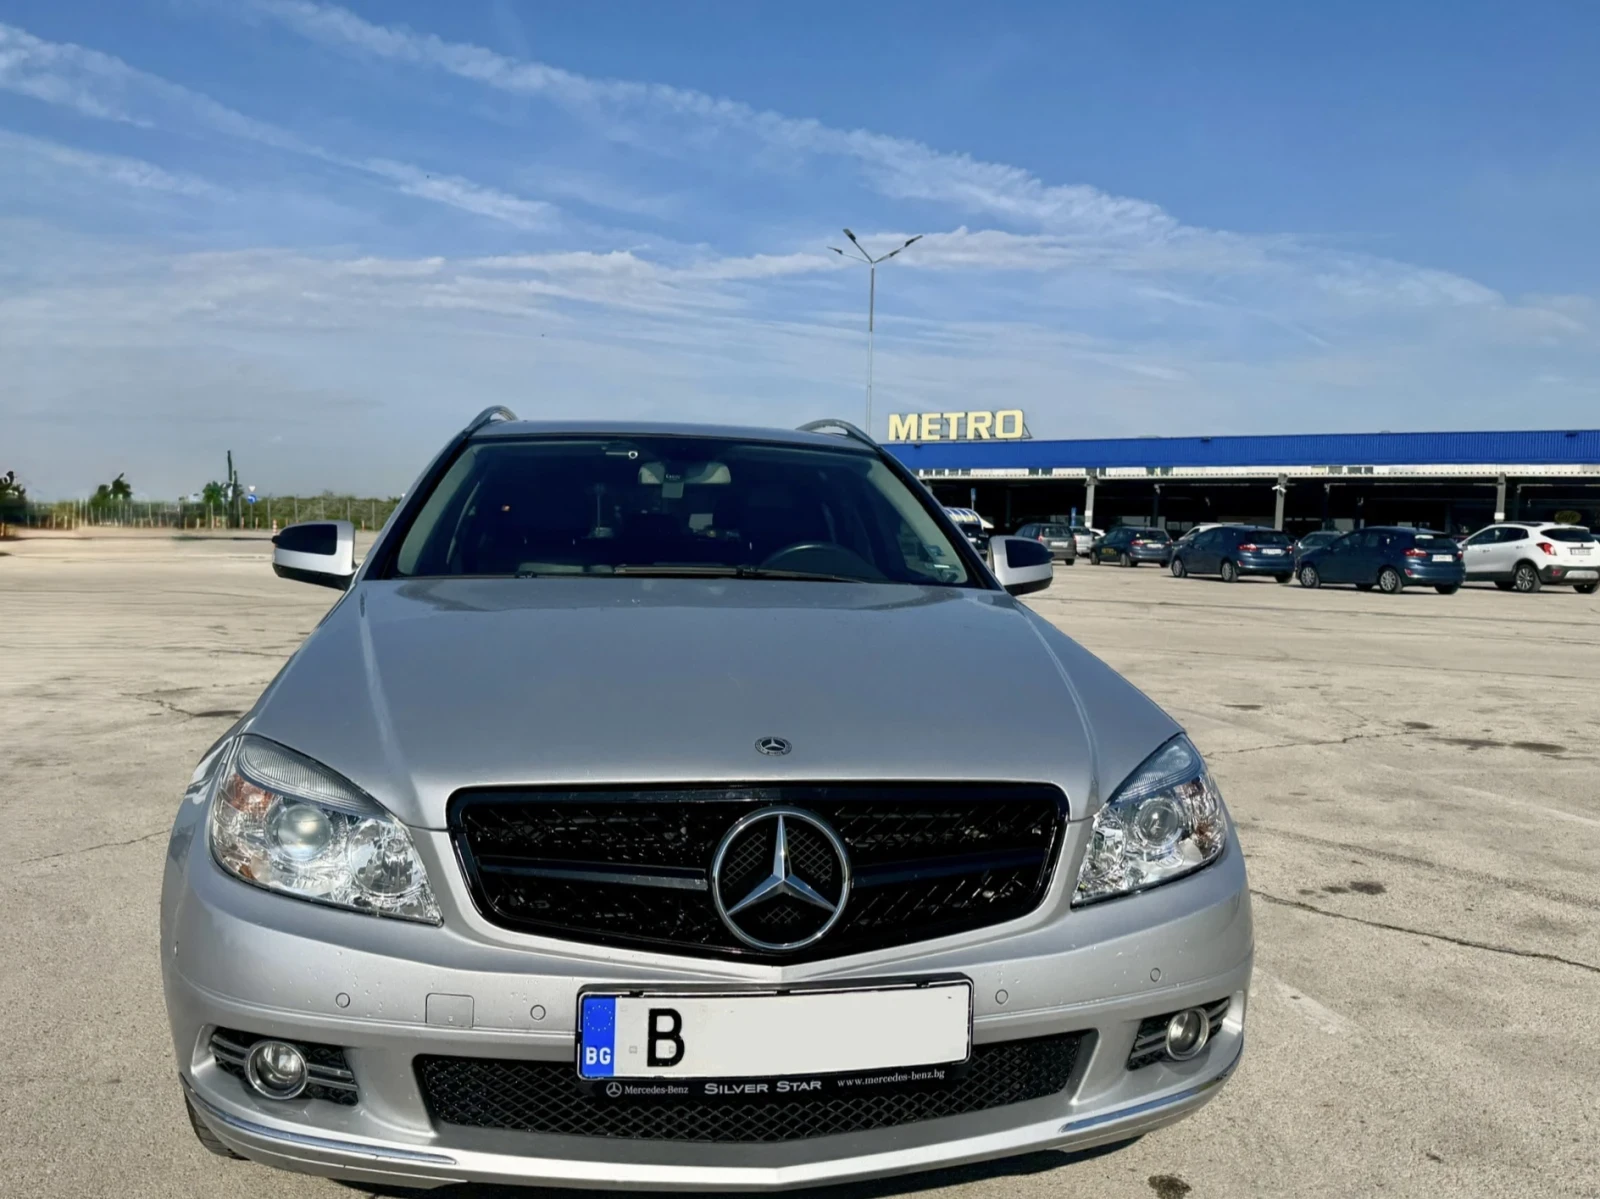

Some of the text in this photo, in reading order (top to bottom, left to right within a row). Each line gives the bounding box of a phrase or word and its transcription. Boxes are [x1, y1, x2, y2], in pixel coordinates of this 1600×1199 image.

[888, 410, 1024, 441] METRO
[647, 1008, 685, 1067] B
[585, 1046, 611, 1065] BG
[837, 1069, 945, 1087] www.mercedes-benz.bg
[624, 1085, 689, 1095] Mercedes-Benz
[704, 1080, 822, 1095] SILVER STAR
